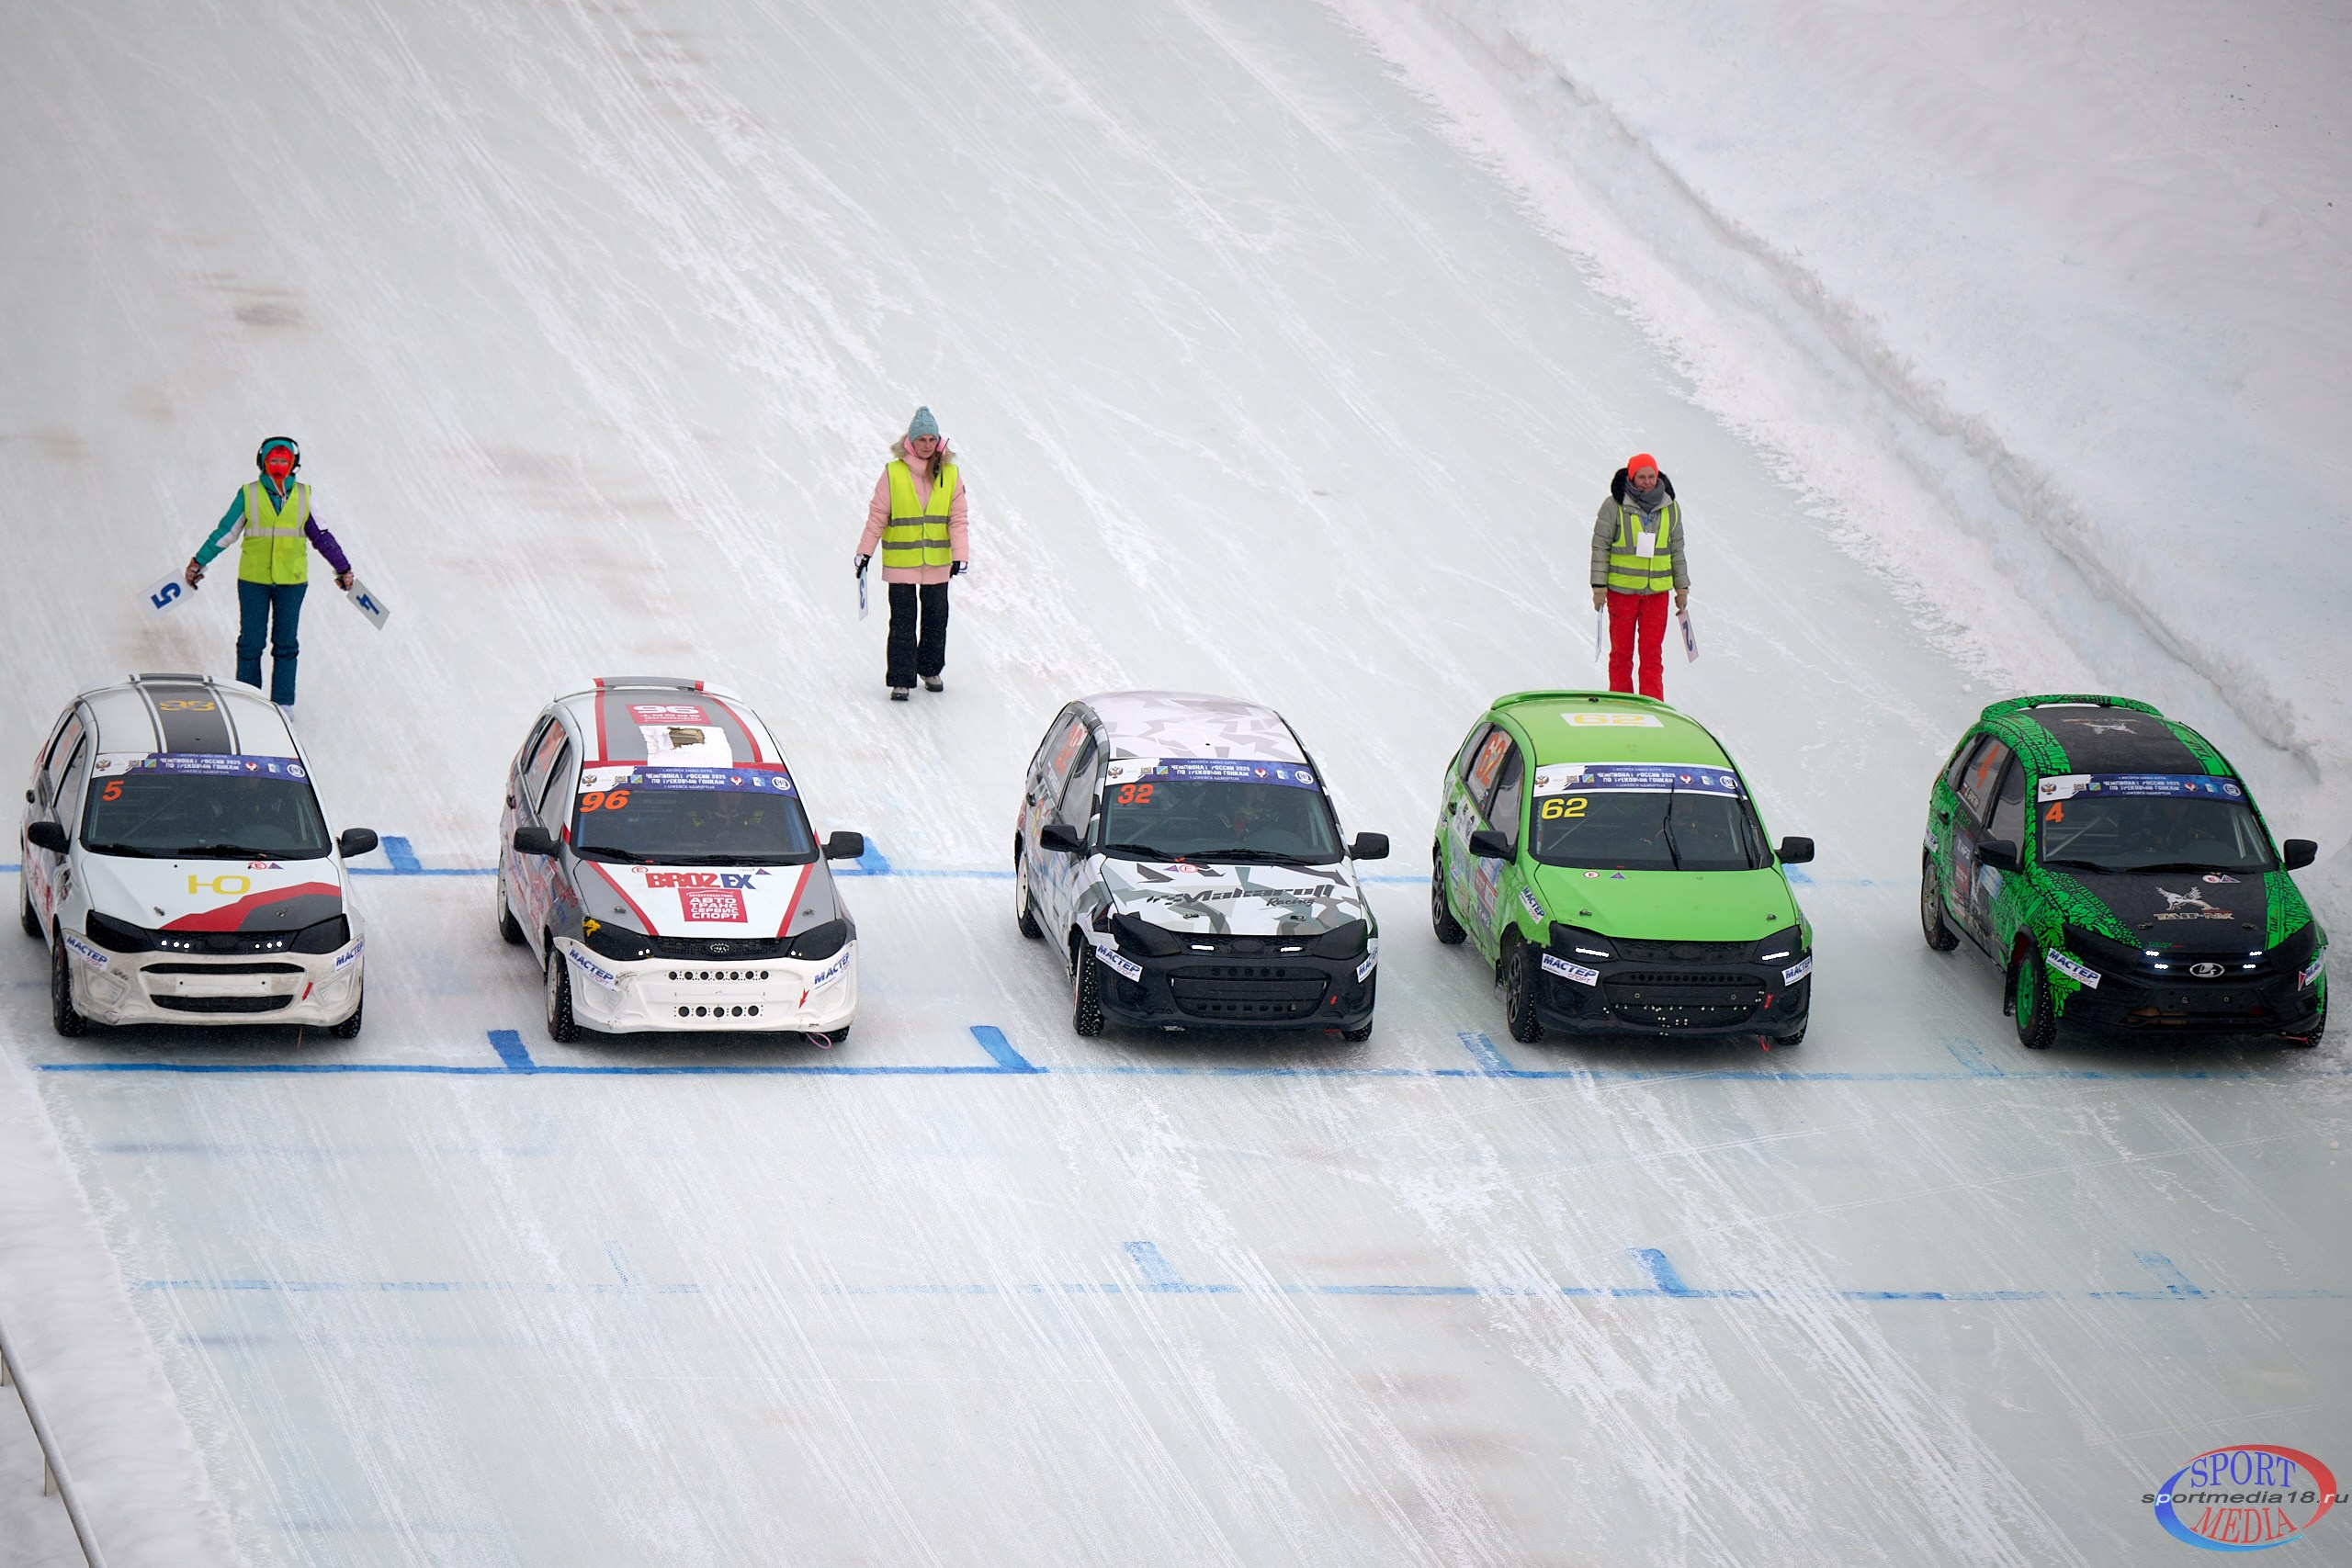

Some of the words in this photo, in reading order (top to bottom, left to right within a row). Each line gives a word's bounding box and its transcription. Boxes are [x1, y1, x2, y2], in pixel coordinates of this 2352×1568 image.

[150, 582, 182, 610] 5
[355, 593, 379, 615] 4
[1682, 620, 1692, 651] 2
[633, 705, 699, 714] 96
[1573, 713, 1645, 725] 62
[102, 780, 124, 801] 5
[579, 790, 631, 813] 96
[1117, 784, 1154, 804] 32
[1541, 797, 1589, 820] 62
[2044, 801, 2064, 823] 4
[187, 874, 251, 895] Ю
[1266, 897, 1315, 908] Racing
[1521, 886, 1545, 917] МАСТЕР
[67, 936, 107, 963] МАСТЕР
[1098, 944, 1140, 972] МАСТЕР
[570, 949, 614, 979] МАСТЕР
[814, 952, 849, 984] МАСТЕР
[1544, 956, 1597, 976] МАСТЕР
[2049, 951, 2099, 979] МАСТЕР
[1567, 974, 1591, 983] СПОРТ
[2072, 973, 2093, 985] СПОРТ
